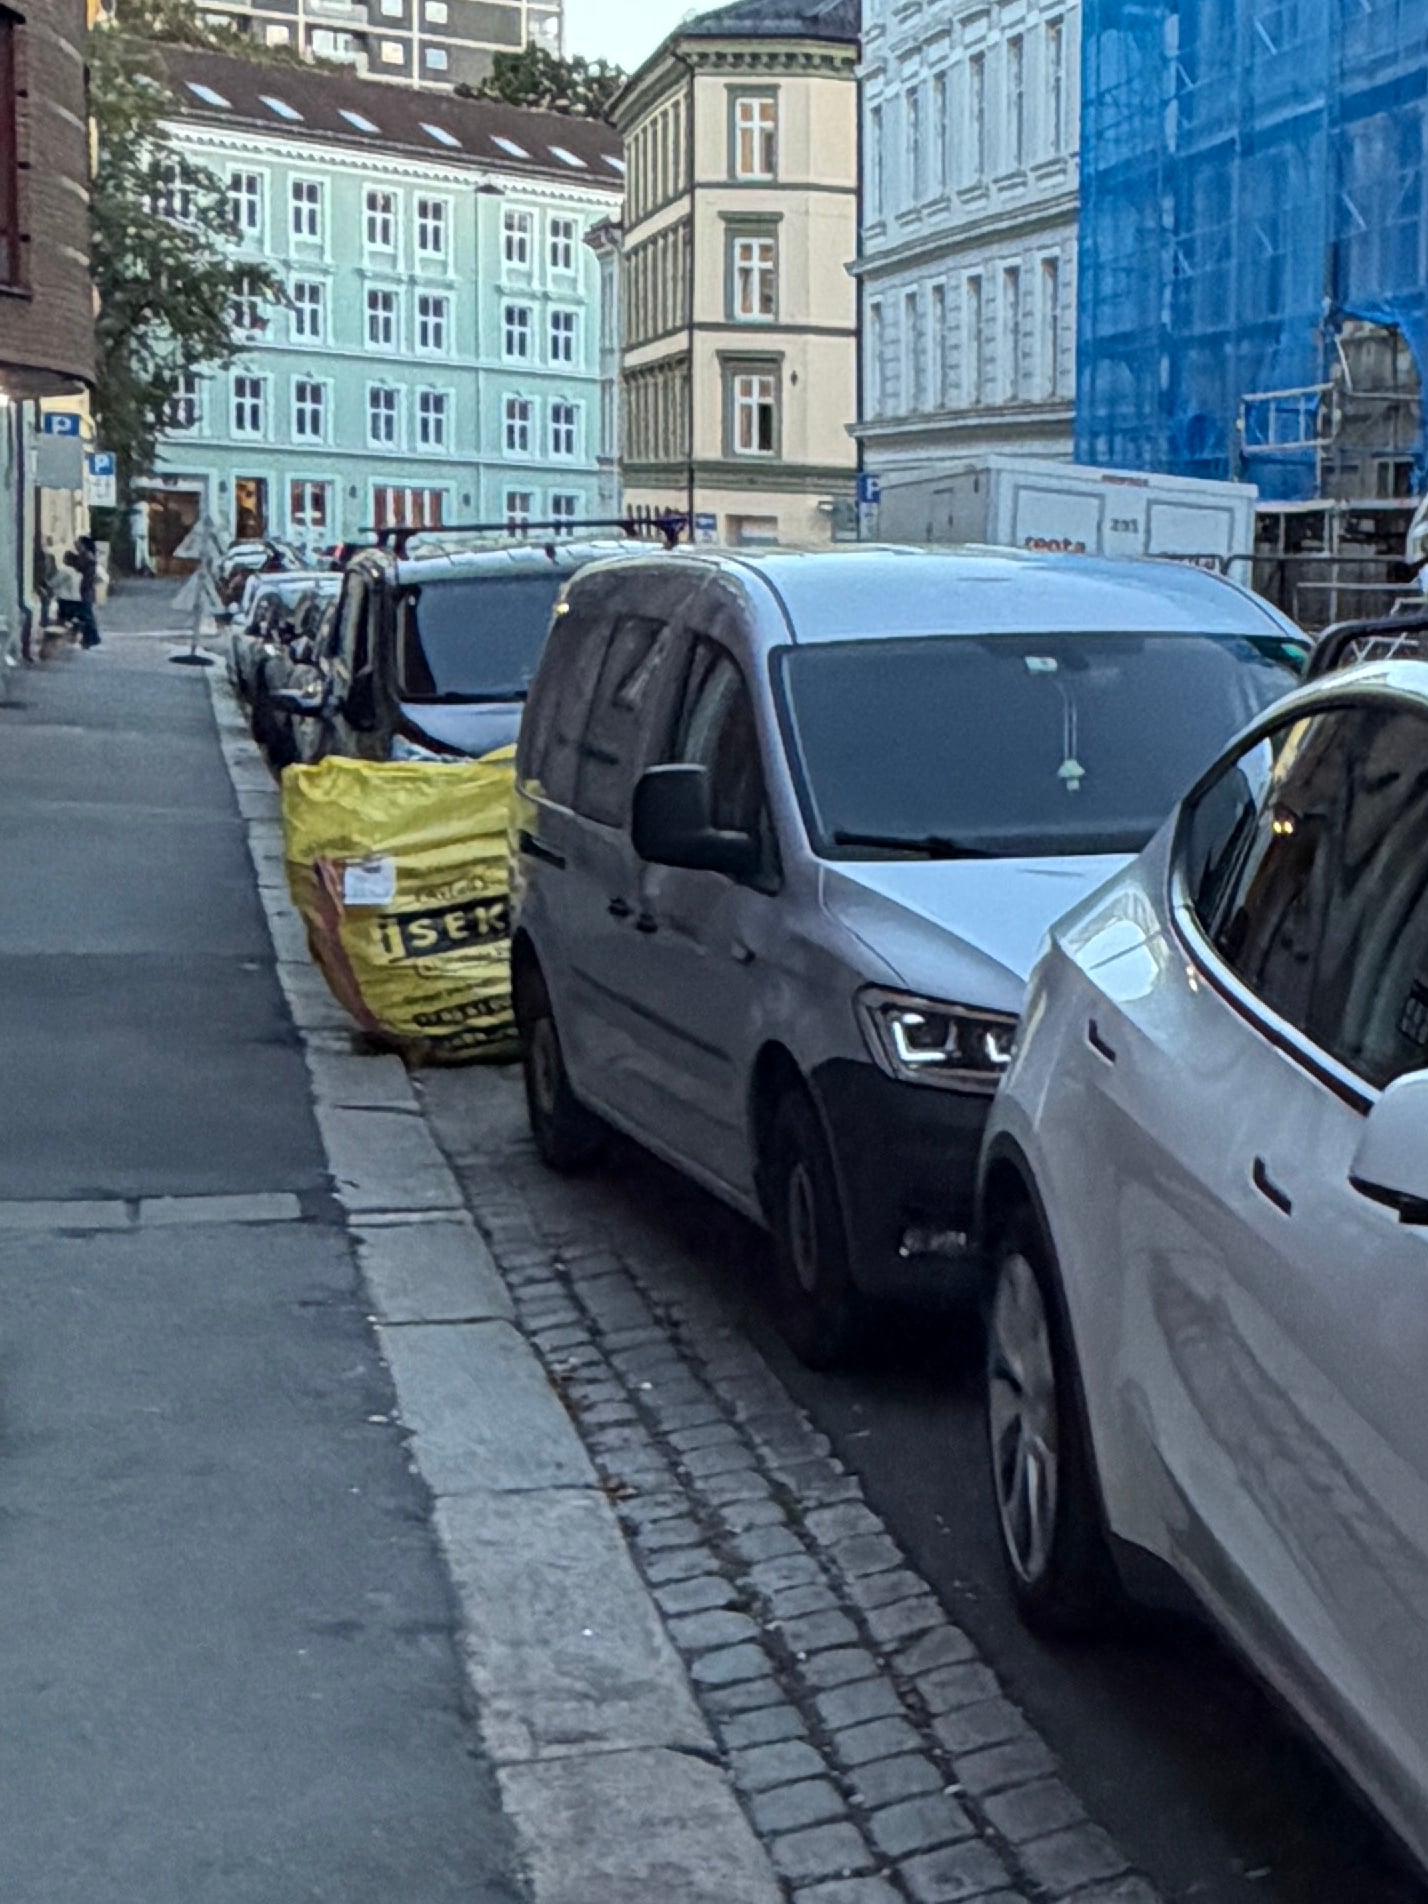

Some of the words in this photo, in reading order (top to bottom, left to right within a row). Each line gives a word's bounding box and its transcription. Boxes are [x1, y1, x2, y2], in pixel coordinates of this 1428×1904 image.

[51, 415, 72, 435] P
[94, 453, 111, 473] P
[377, 902, 507, 955] iSEK
